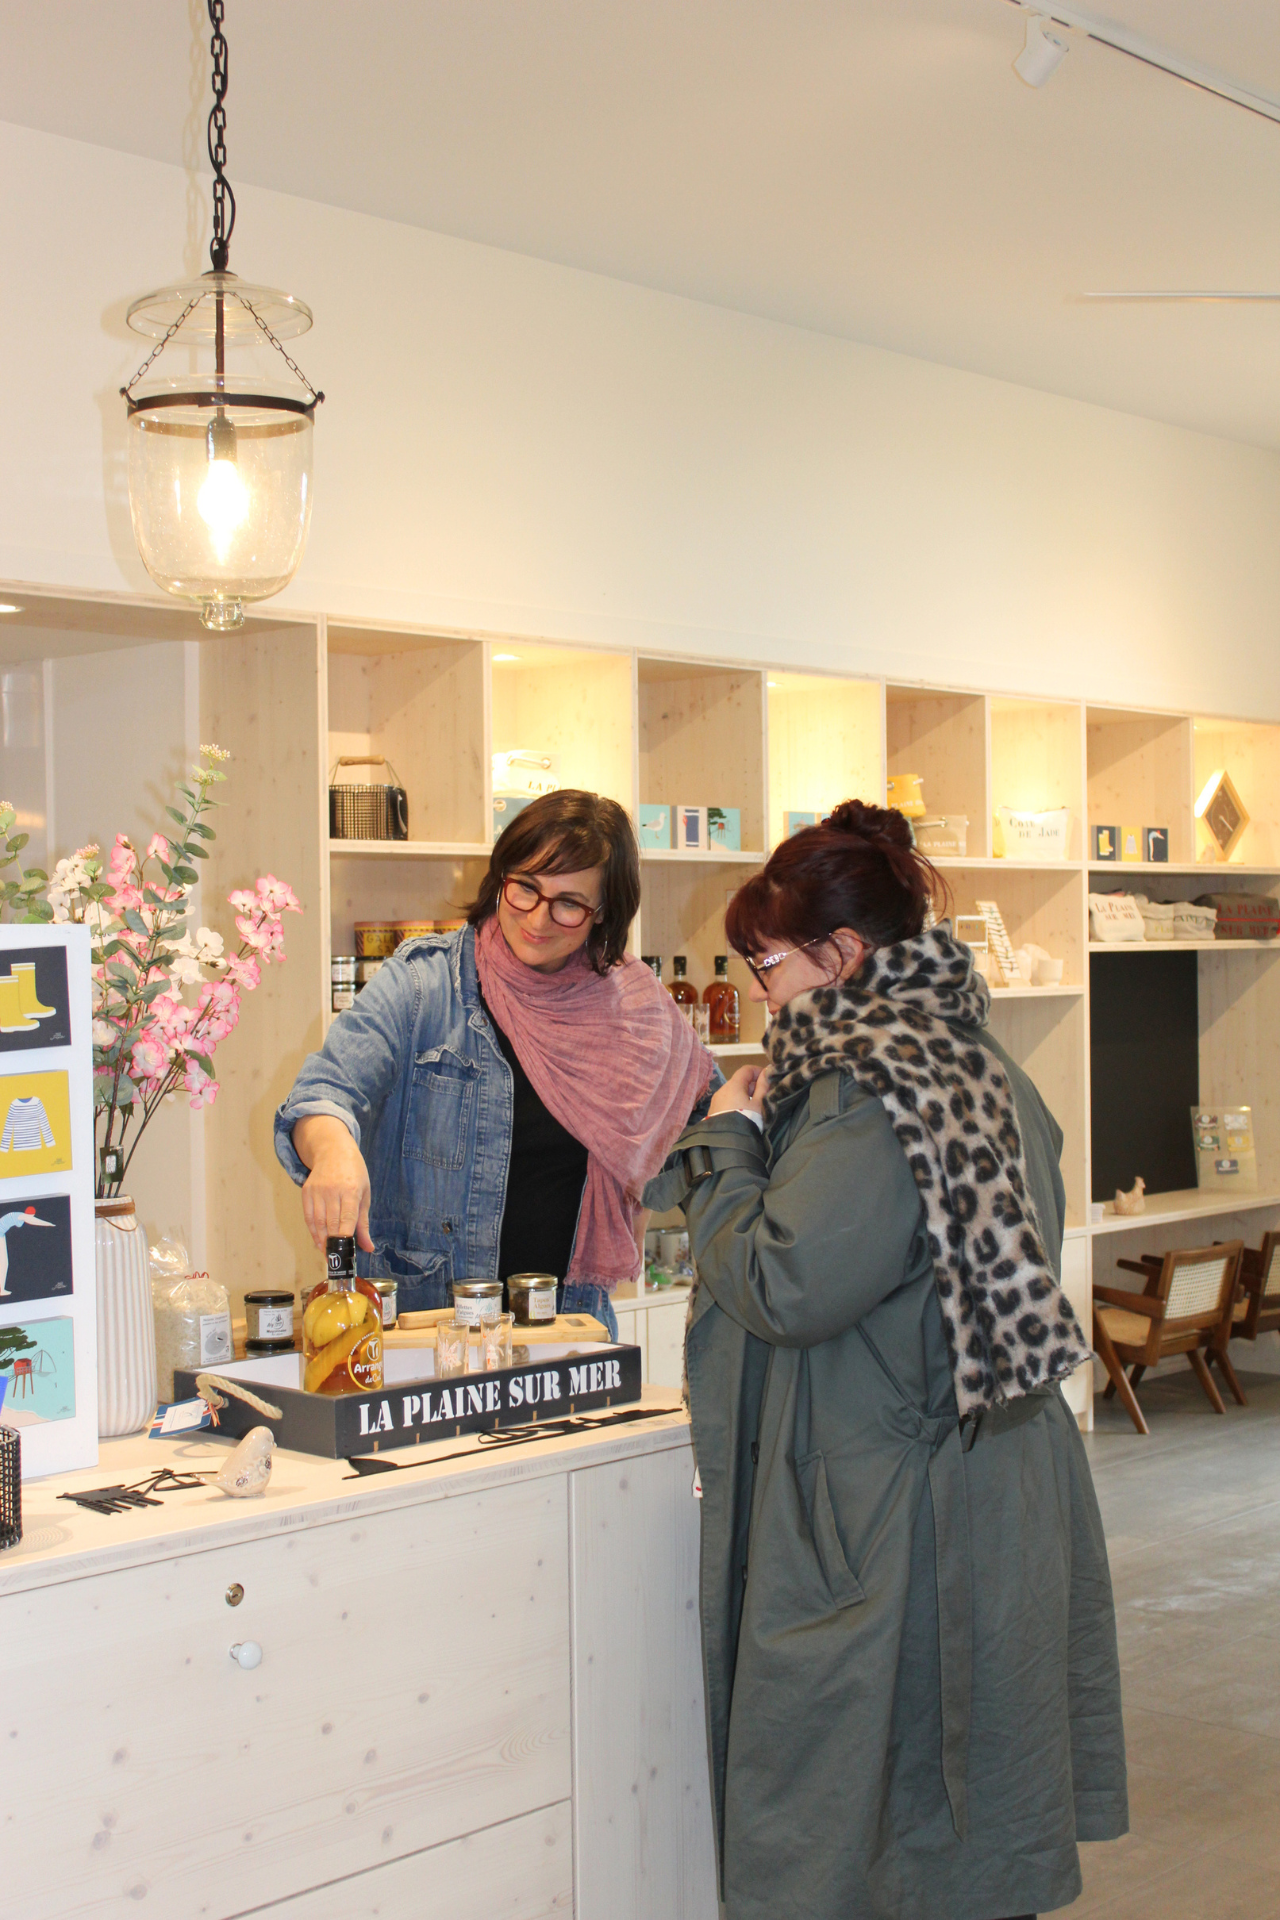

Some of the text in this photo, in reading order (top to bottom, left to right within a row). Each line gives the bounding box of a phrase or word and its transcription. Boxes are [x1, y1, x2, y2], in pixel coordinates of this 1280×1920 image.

[359, 1359, 622, 1436] LA PLAINE SUR MER
